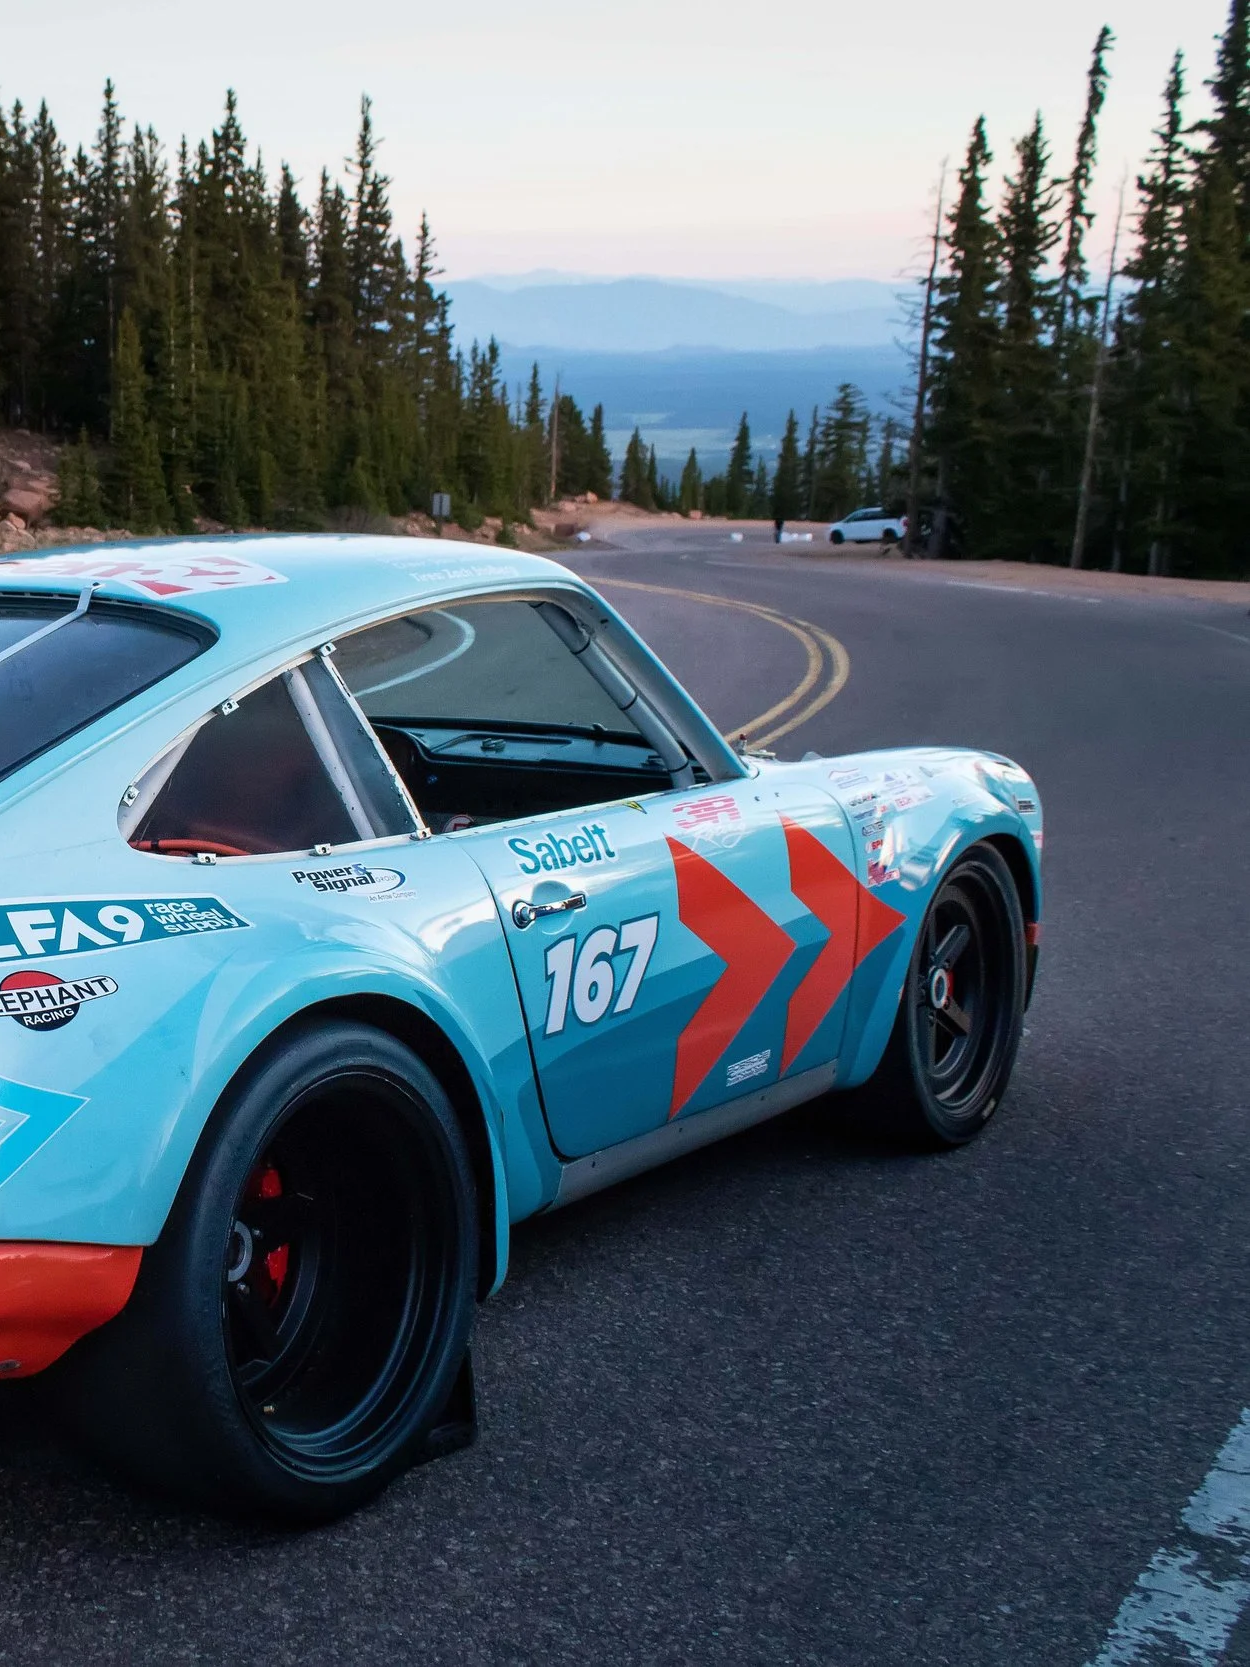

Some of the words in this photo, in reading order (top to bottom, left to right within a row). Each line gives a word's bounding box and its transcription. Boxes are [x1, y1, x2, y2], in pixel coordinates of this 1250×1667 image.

[508, 823, 616, 875] Sabelt
[313, 872, 376, 892] Signal
[375, 875, 398, 883] GROUP
[144, 900, 198, 915] race
[152, 909, 225, 925] wheel
[165, 916, 240, 935] supply
[544, 912, 659, 1038] 167
[22, 1007, 75, 1026] RACING
